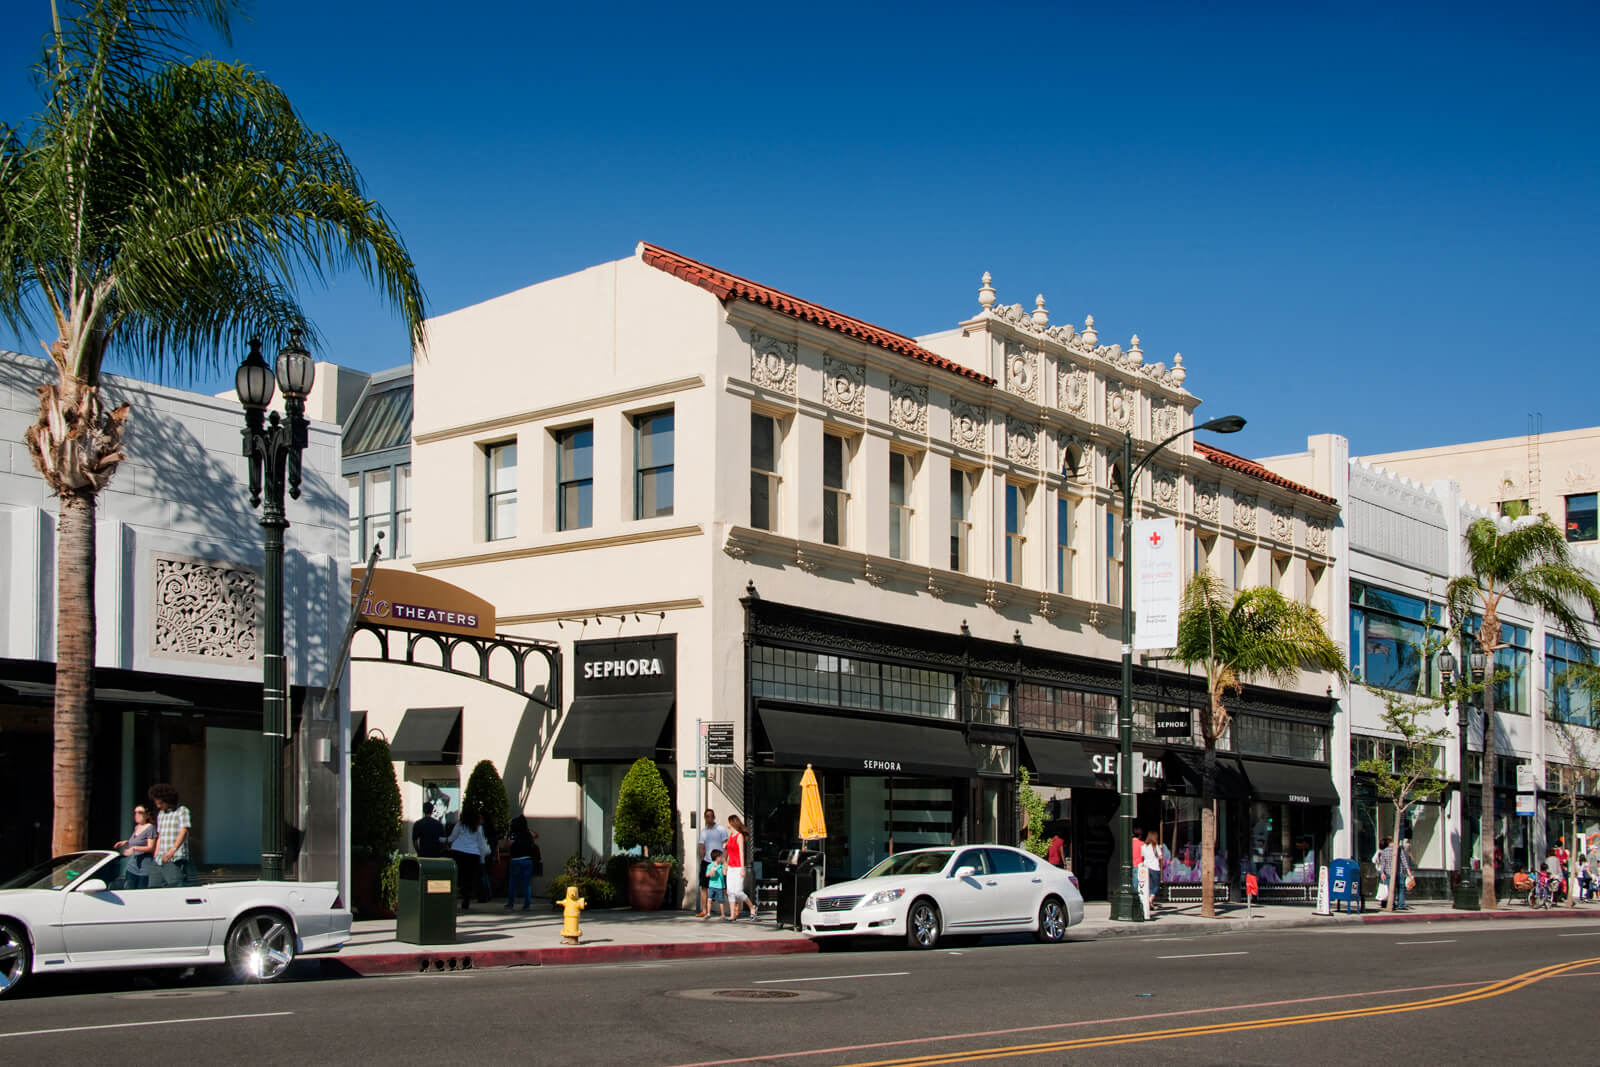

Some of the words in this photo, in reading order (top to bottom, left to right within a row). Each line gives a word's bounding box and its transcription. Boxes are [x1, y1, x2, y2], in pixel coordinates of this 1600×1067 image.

[395, 605, 477, 627] THEATERS
[583, 658, 663, 679] SEPHORA
[863, 759, 902, 771] SEPHORA
[1092, 754, 1164, 779] SEORA
